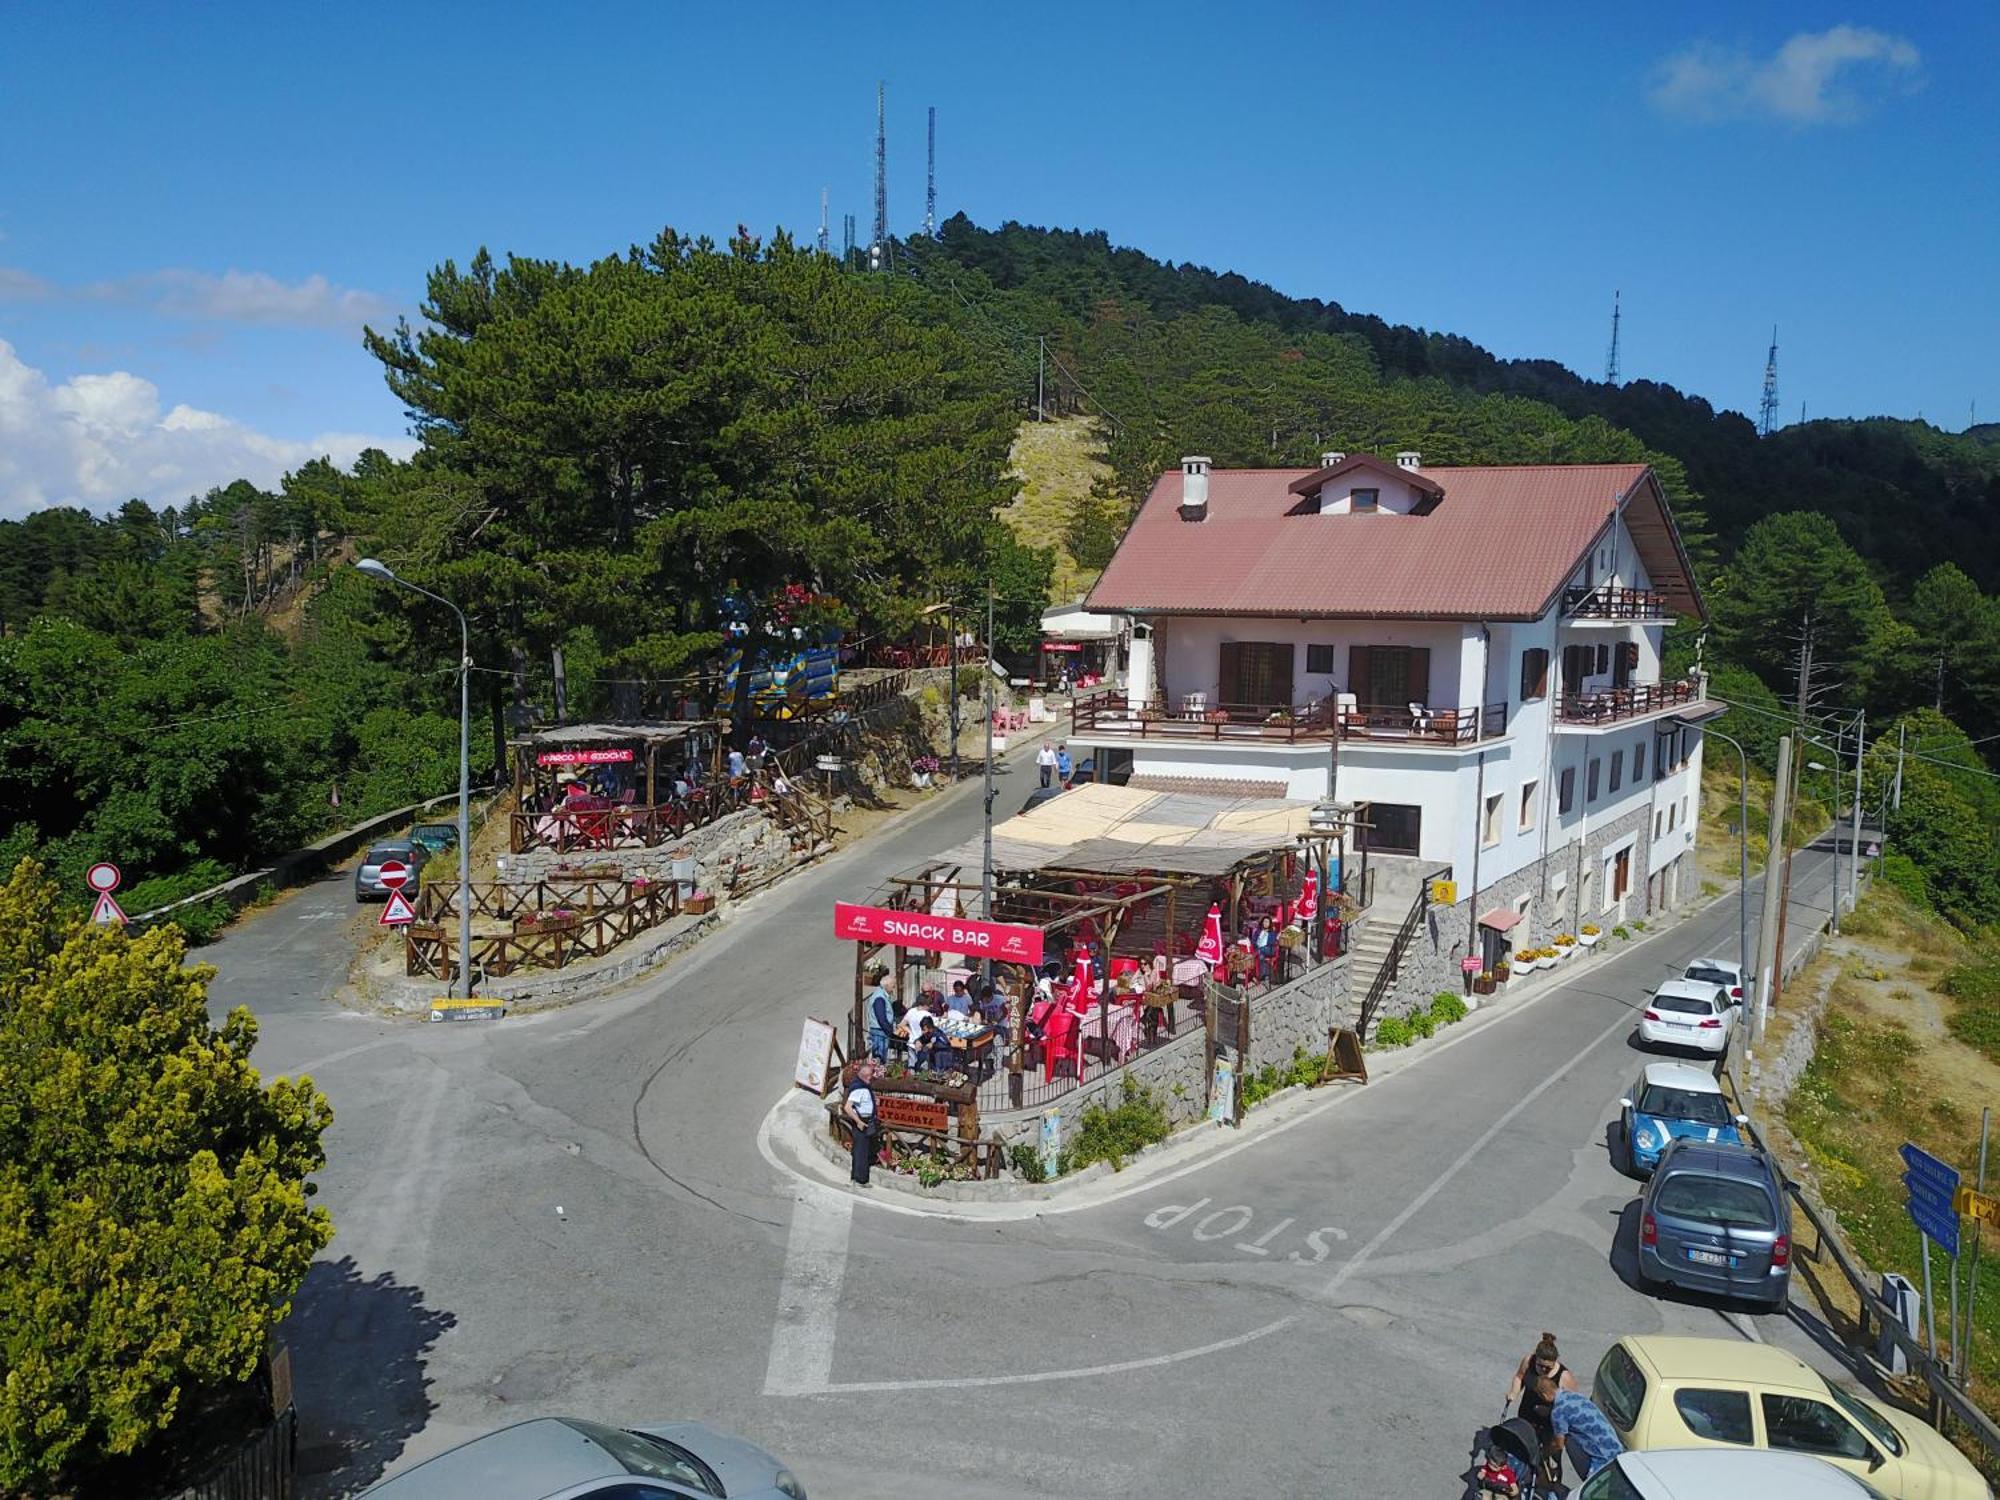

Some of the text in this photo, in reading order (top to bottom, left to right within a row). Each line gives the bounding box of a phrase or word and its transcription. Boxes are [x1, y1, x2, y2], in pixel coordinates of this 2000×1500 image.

[542, 750, 629, 762] PARCO GIOCHI
[883, 919, 945, 941] SNACK
[952, 928, 990, 948] BAR
[1143, 1196, 1349, 1266] STOP
